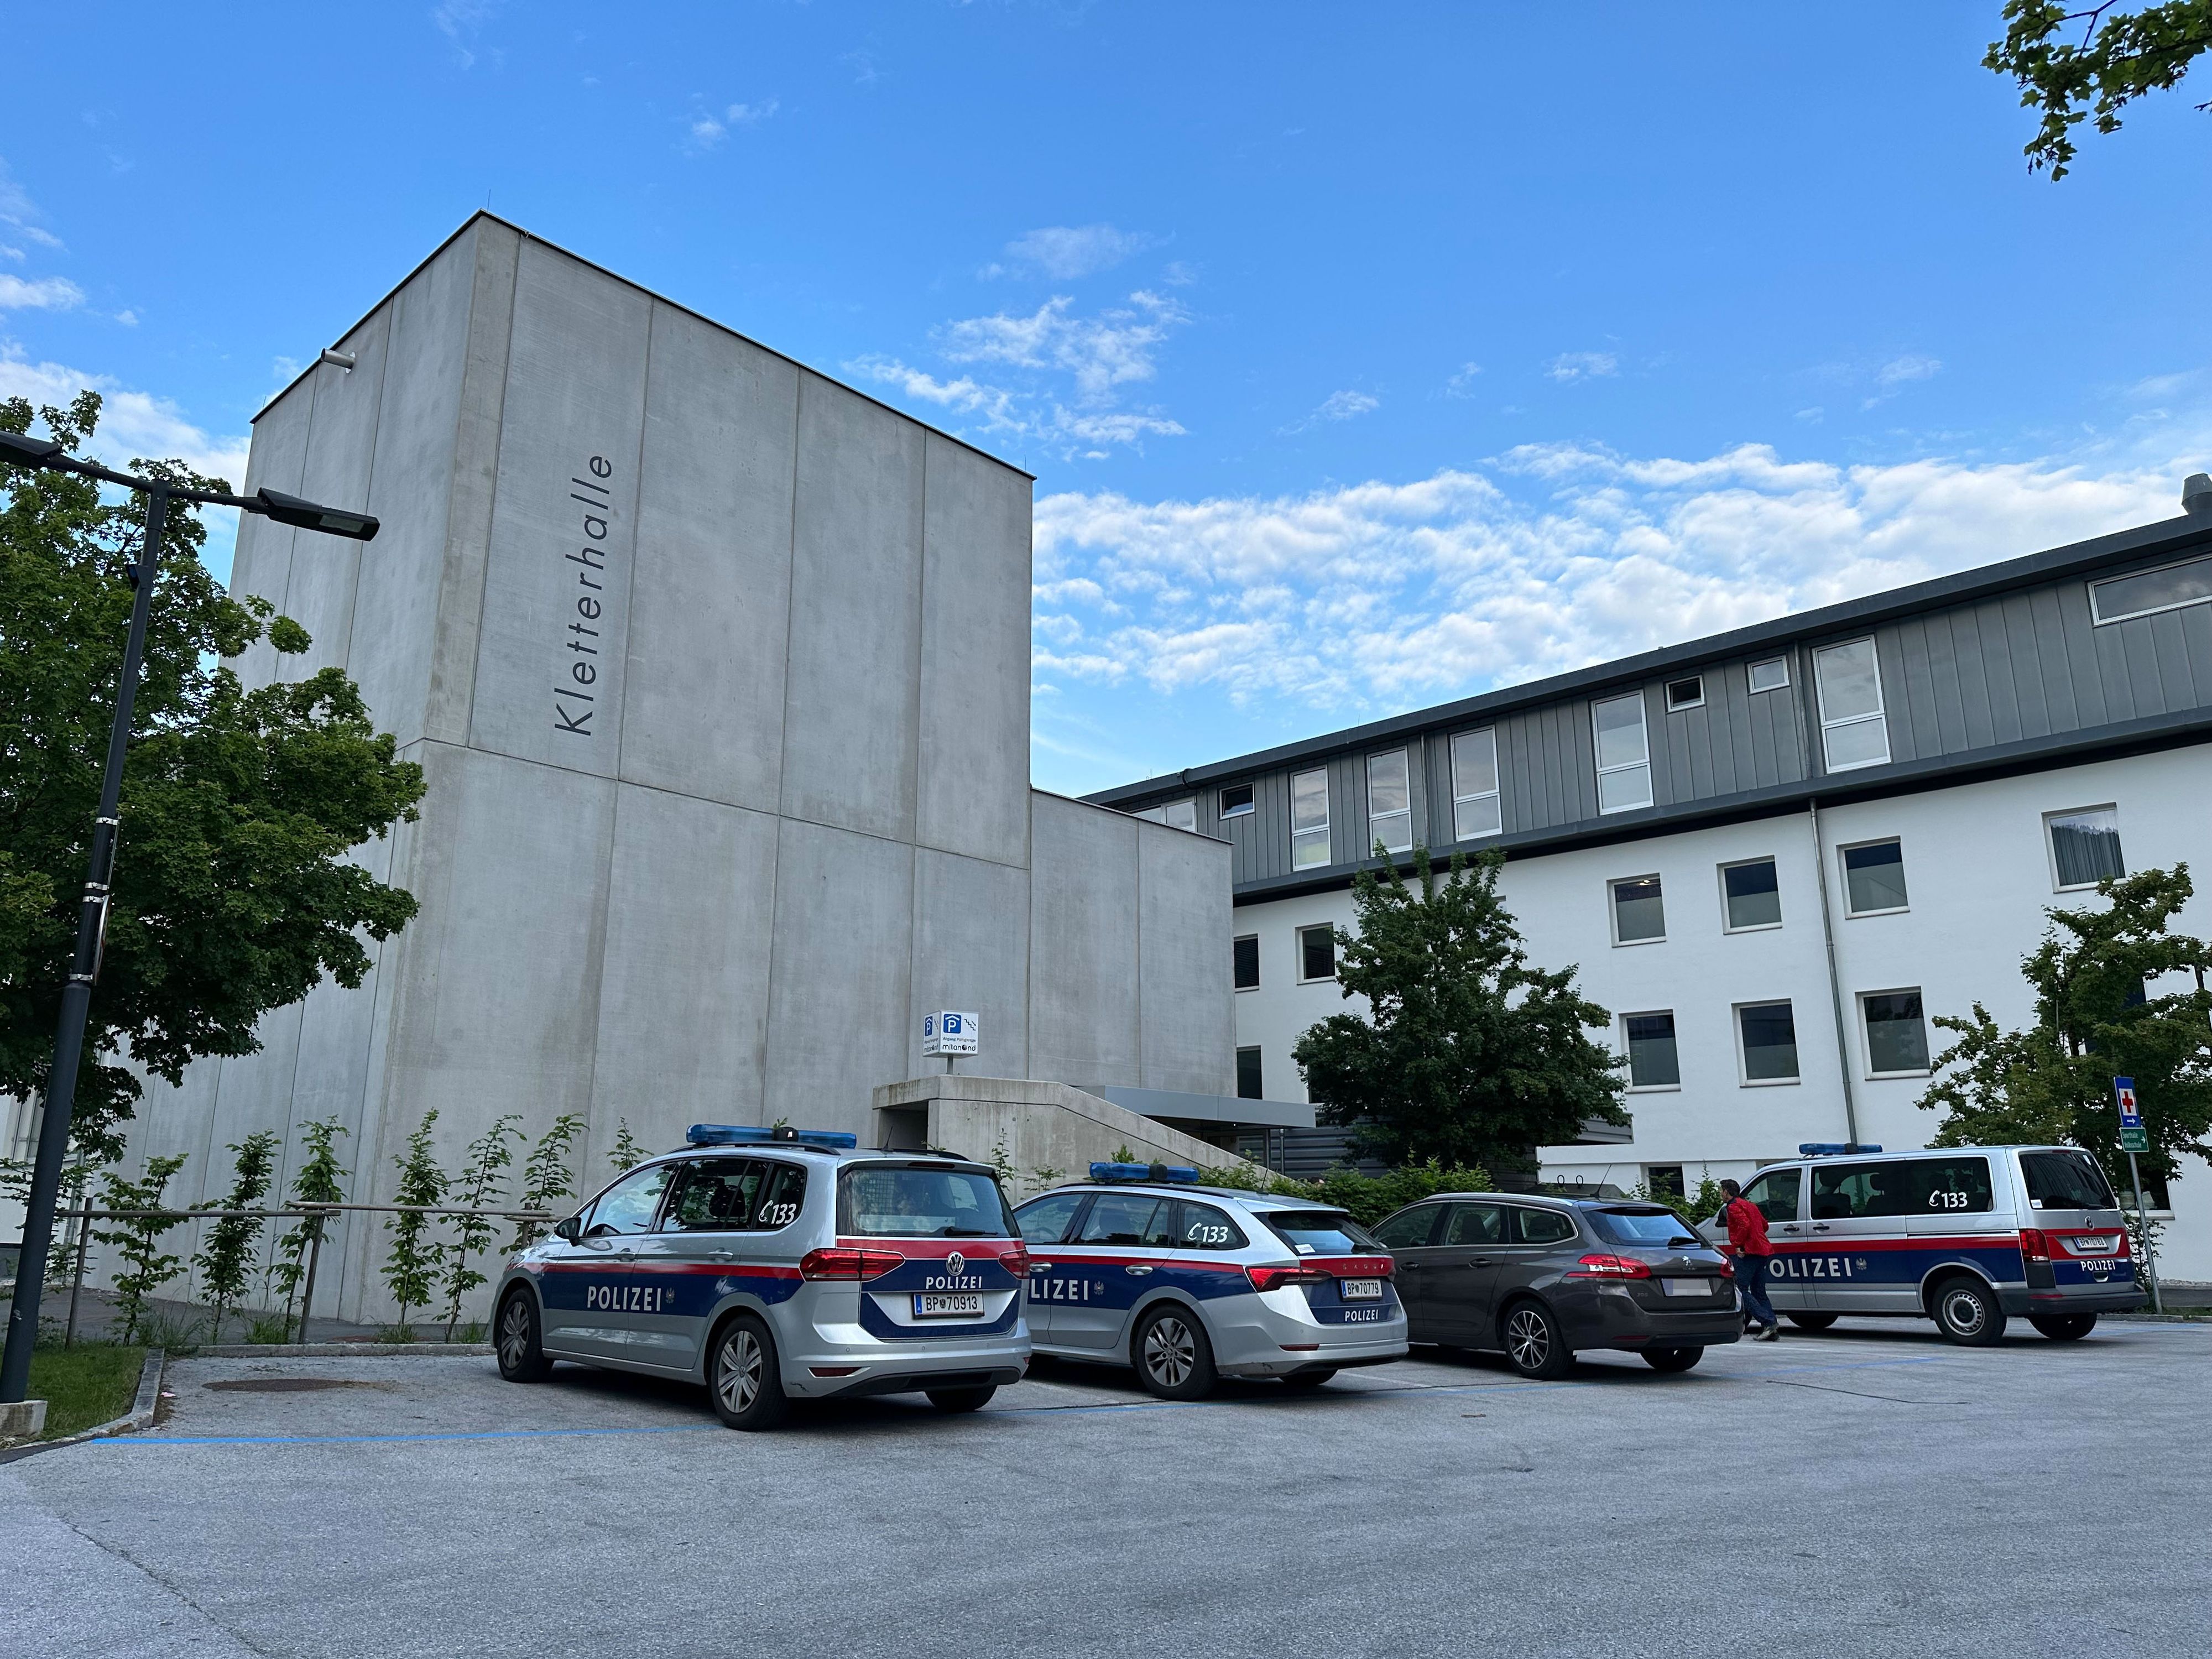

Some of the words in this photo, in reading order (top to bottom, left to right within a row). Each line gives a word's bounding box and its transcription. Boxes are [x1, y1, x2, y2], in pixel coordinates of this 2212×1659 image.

[554, 455, 612, 736] Kletterhalle
[948, 1019, 957, 1032] P
[1941, 1192, 1968, 1208] 133
[771, 1203, 797, 1224] 133
[1202, 1225, 1229, 1243] 133
[1769, 1258, 1852, 1277] OLIZEI
[2080, 1260, 2116, 1271] POLIZEI
[926, 1276, 982, 1290] POLIZEI
[1031, 1279, 1089, 1301] LIZEI
[1359, 1282, 1379, 1295] 70779
[587, 1286, 661, 1312] POLIZEI
[926, 1297, 938, 1311] BP
[947, 1296, 978, 1311] 70913
[1344, 1309, 1379, 1322] POLIZEI
